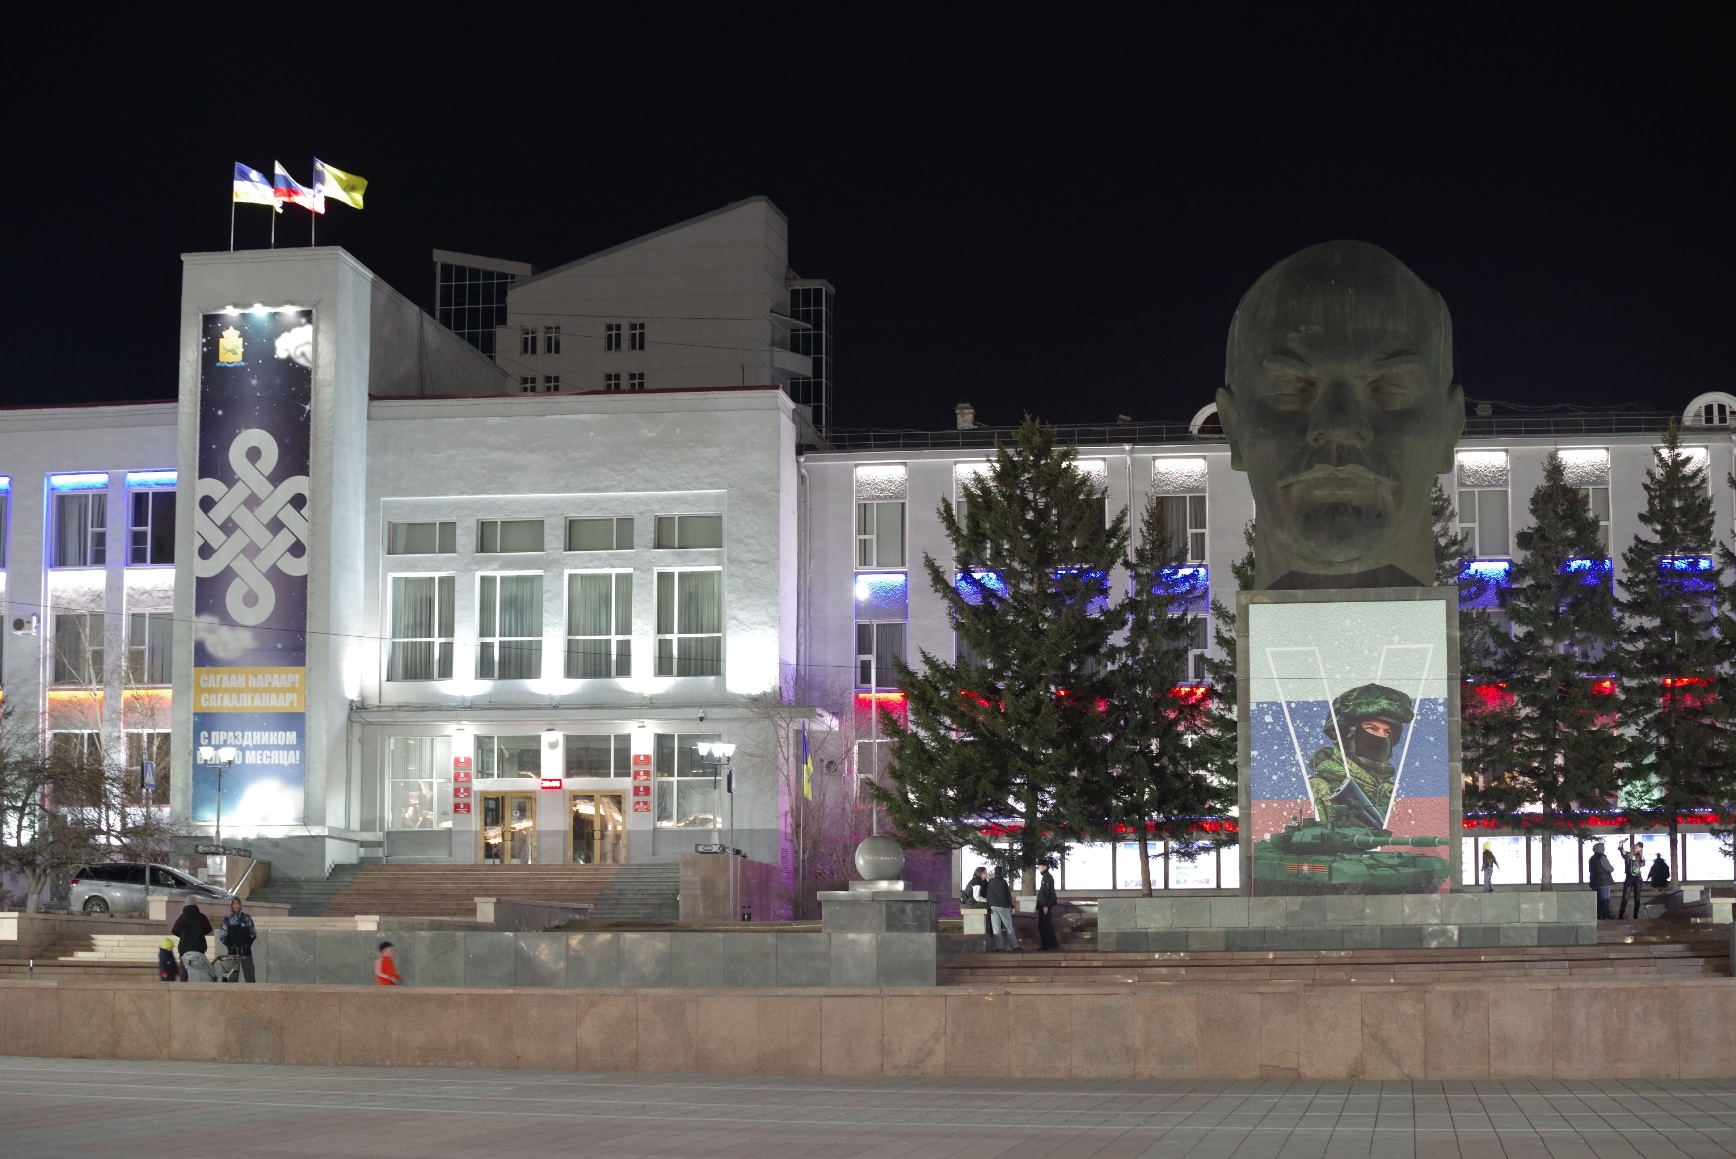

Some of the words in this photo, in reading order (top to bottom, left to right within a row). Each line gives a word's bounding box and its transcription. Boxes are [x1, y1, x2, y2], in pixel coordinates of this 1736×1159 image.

[201, 673, 245, 688] САГААН
[202, 693, 297, 707] САГААЛГАНААР!
[200, 731, 208, 745] С
[211, 731, 296, 747] ПРАЗДНИКОМ
[245, 750, 300, 766] МЕСЯЦА!
